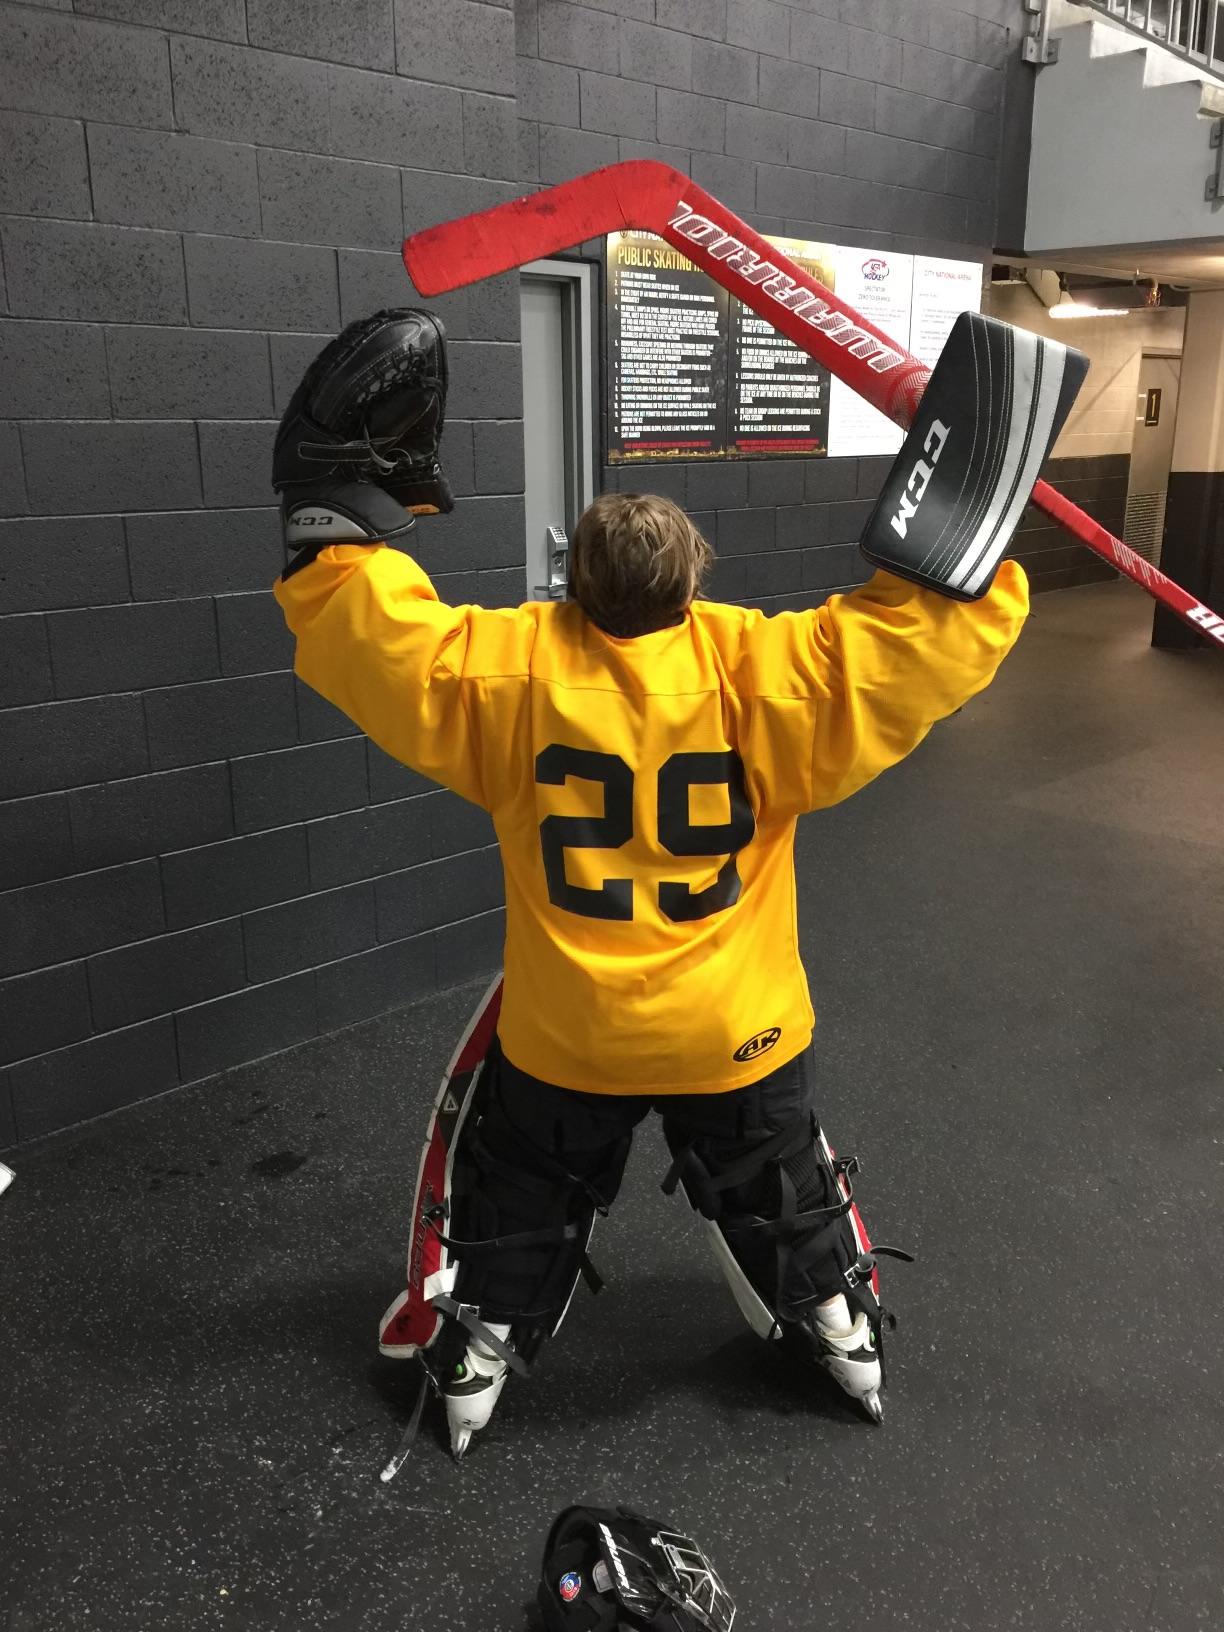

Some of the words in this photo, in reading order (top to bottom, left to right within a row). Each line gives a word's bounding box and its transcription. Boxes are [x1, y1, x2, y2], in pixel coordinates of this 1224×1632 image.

[618, 246, 652, 268] PUBLIC
[653, 249, 692, 271] SKATING
[863, 272, 886, 281] HOCKEY
[891, 419, 952, 540] CCM
[290, 516, 333, 526] CCM
[535, 744, 756, 922] 29
